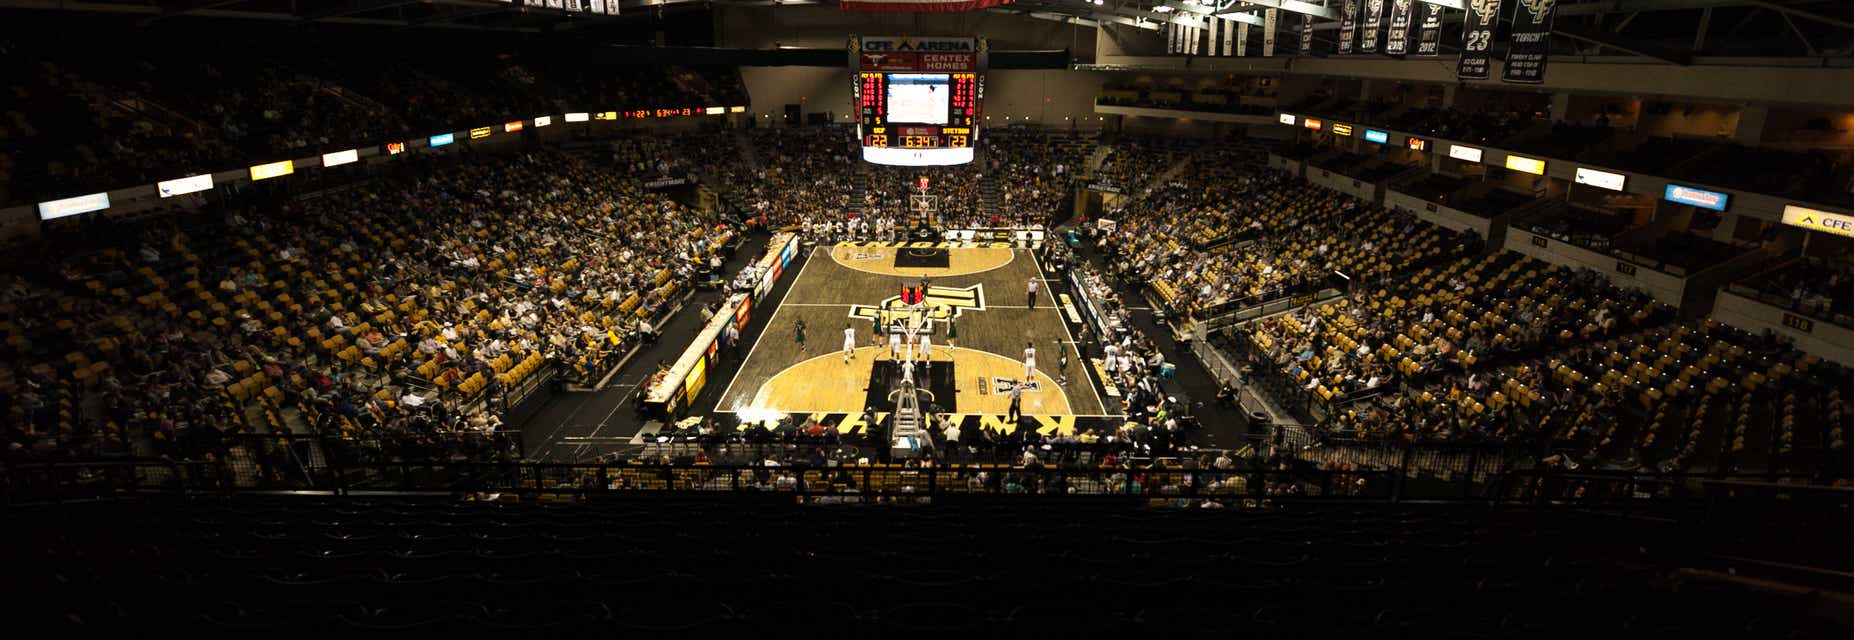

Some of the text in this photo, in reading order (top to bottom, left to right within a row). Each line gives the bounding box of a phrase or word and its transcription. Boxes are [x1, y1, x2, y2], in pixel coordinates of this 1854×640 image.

[917, 41, 970, 50] ARENA
[1466, 30, 1491, 51] 23
[923, 54, 971, 62] CENTEX
[926, 62, 968, 70] HOMES
[872, 135, 887, 147] 22
[906, 135, 930, 148] 6:34
[951, 135, 967, 147] 23
[1822, 217, 1853, 232] CFE
